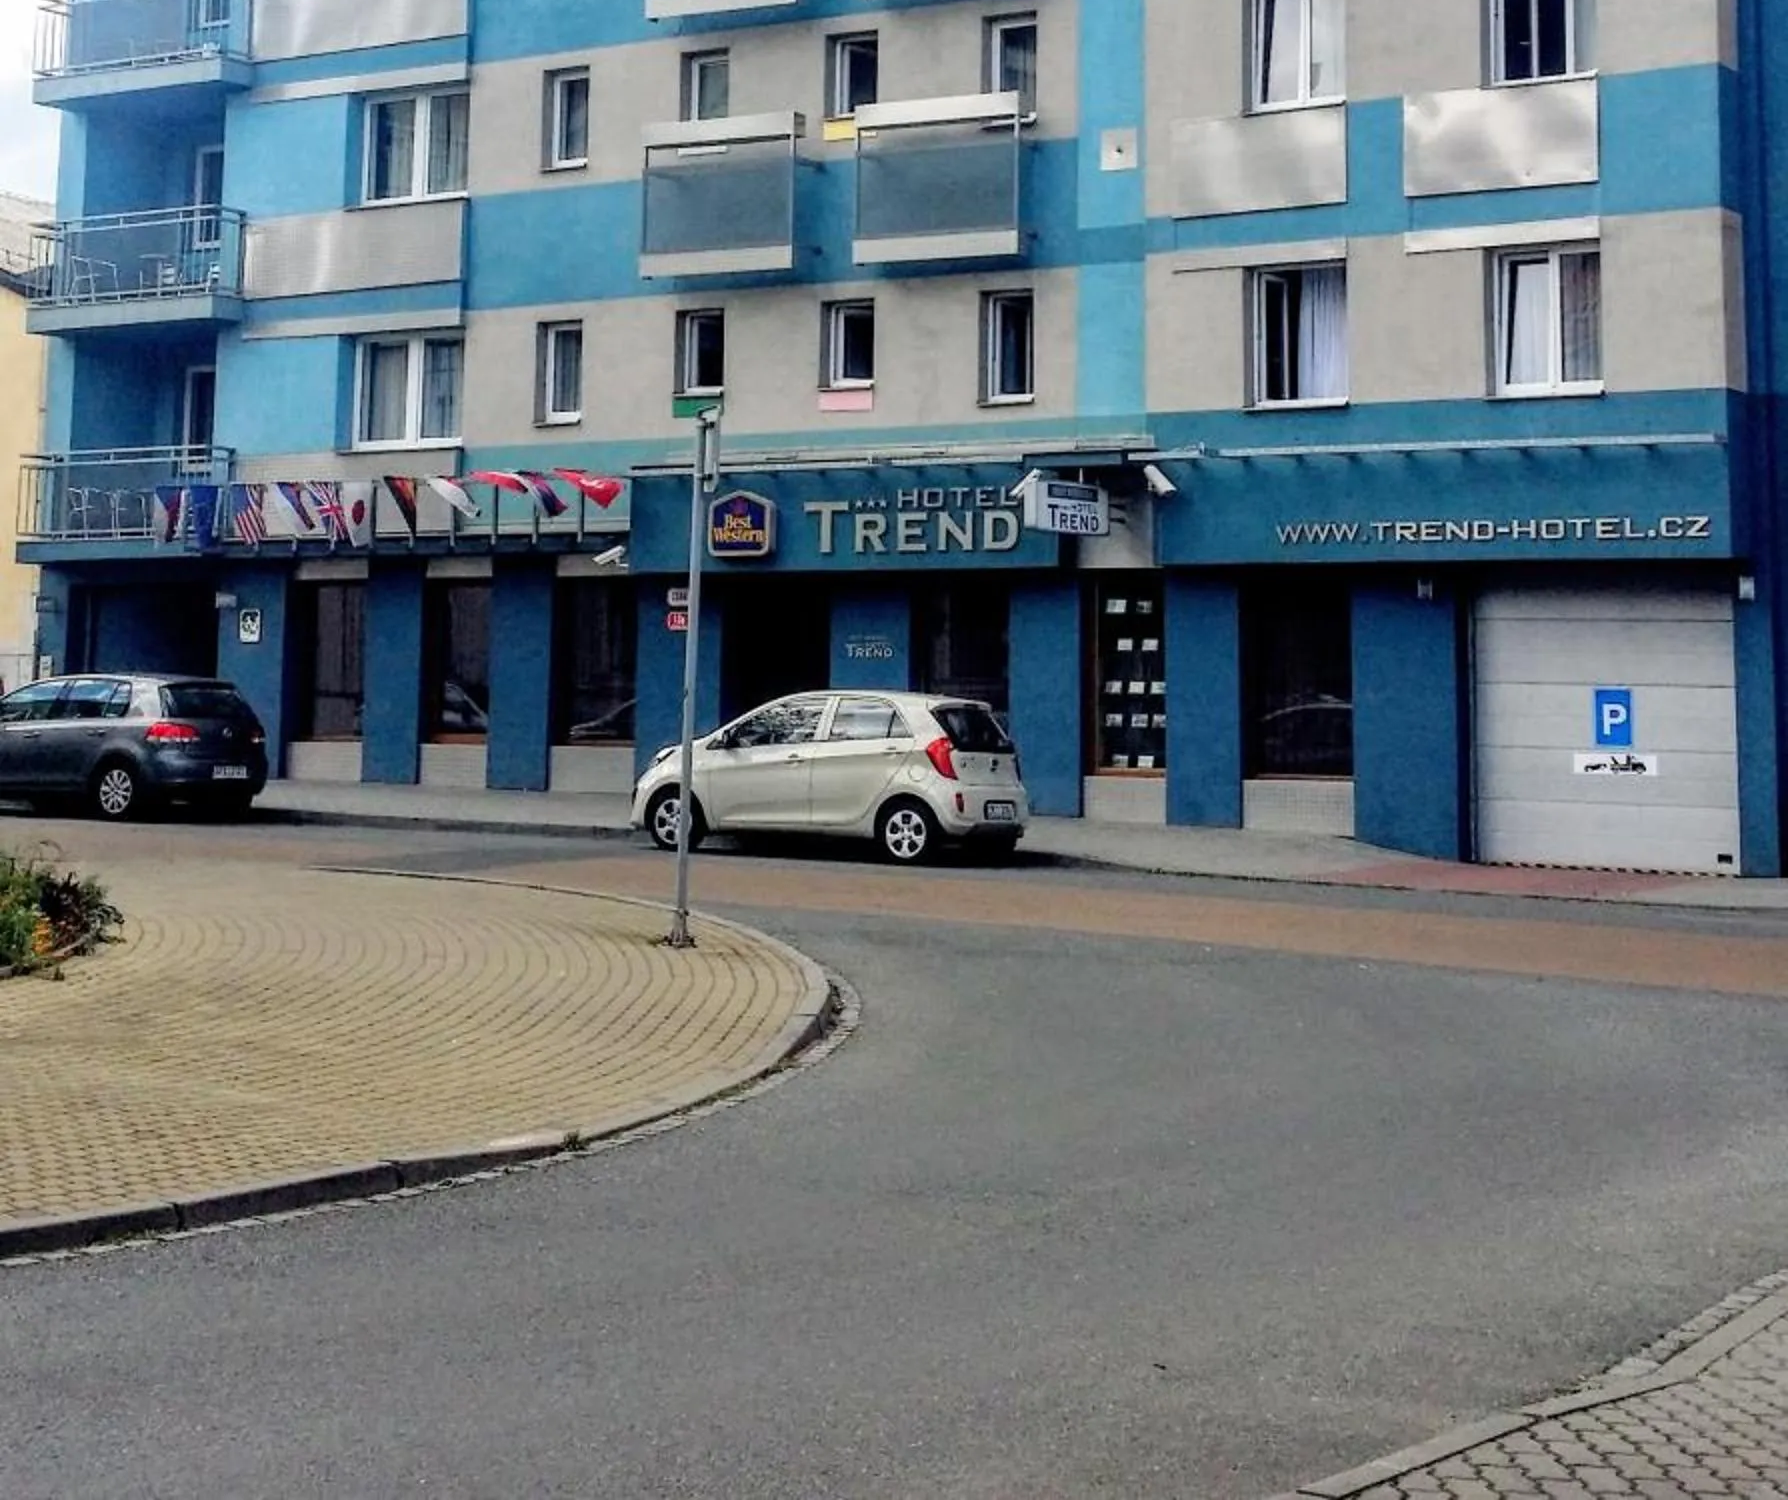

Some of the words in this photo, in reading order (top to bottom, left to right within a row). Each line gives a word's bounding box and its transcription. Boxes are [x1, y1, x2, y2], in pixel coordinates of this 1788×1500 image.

[897, 486, 1018, 508] HOTEL
[725, 513, 751, 528] Best
[803, 500, 1019, 553] TREND
[1047, 504, 1099, 533] TREND
[1276, 515, 1711, 545] WWW.TREND-HOTEL.CZ
[1602, 703, 1627, 736] P
